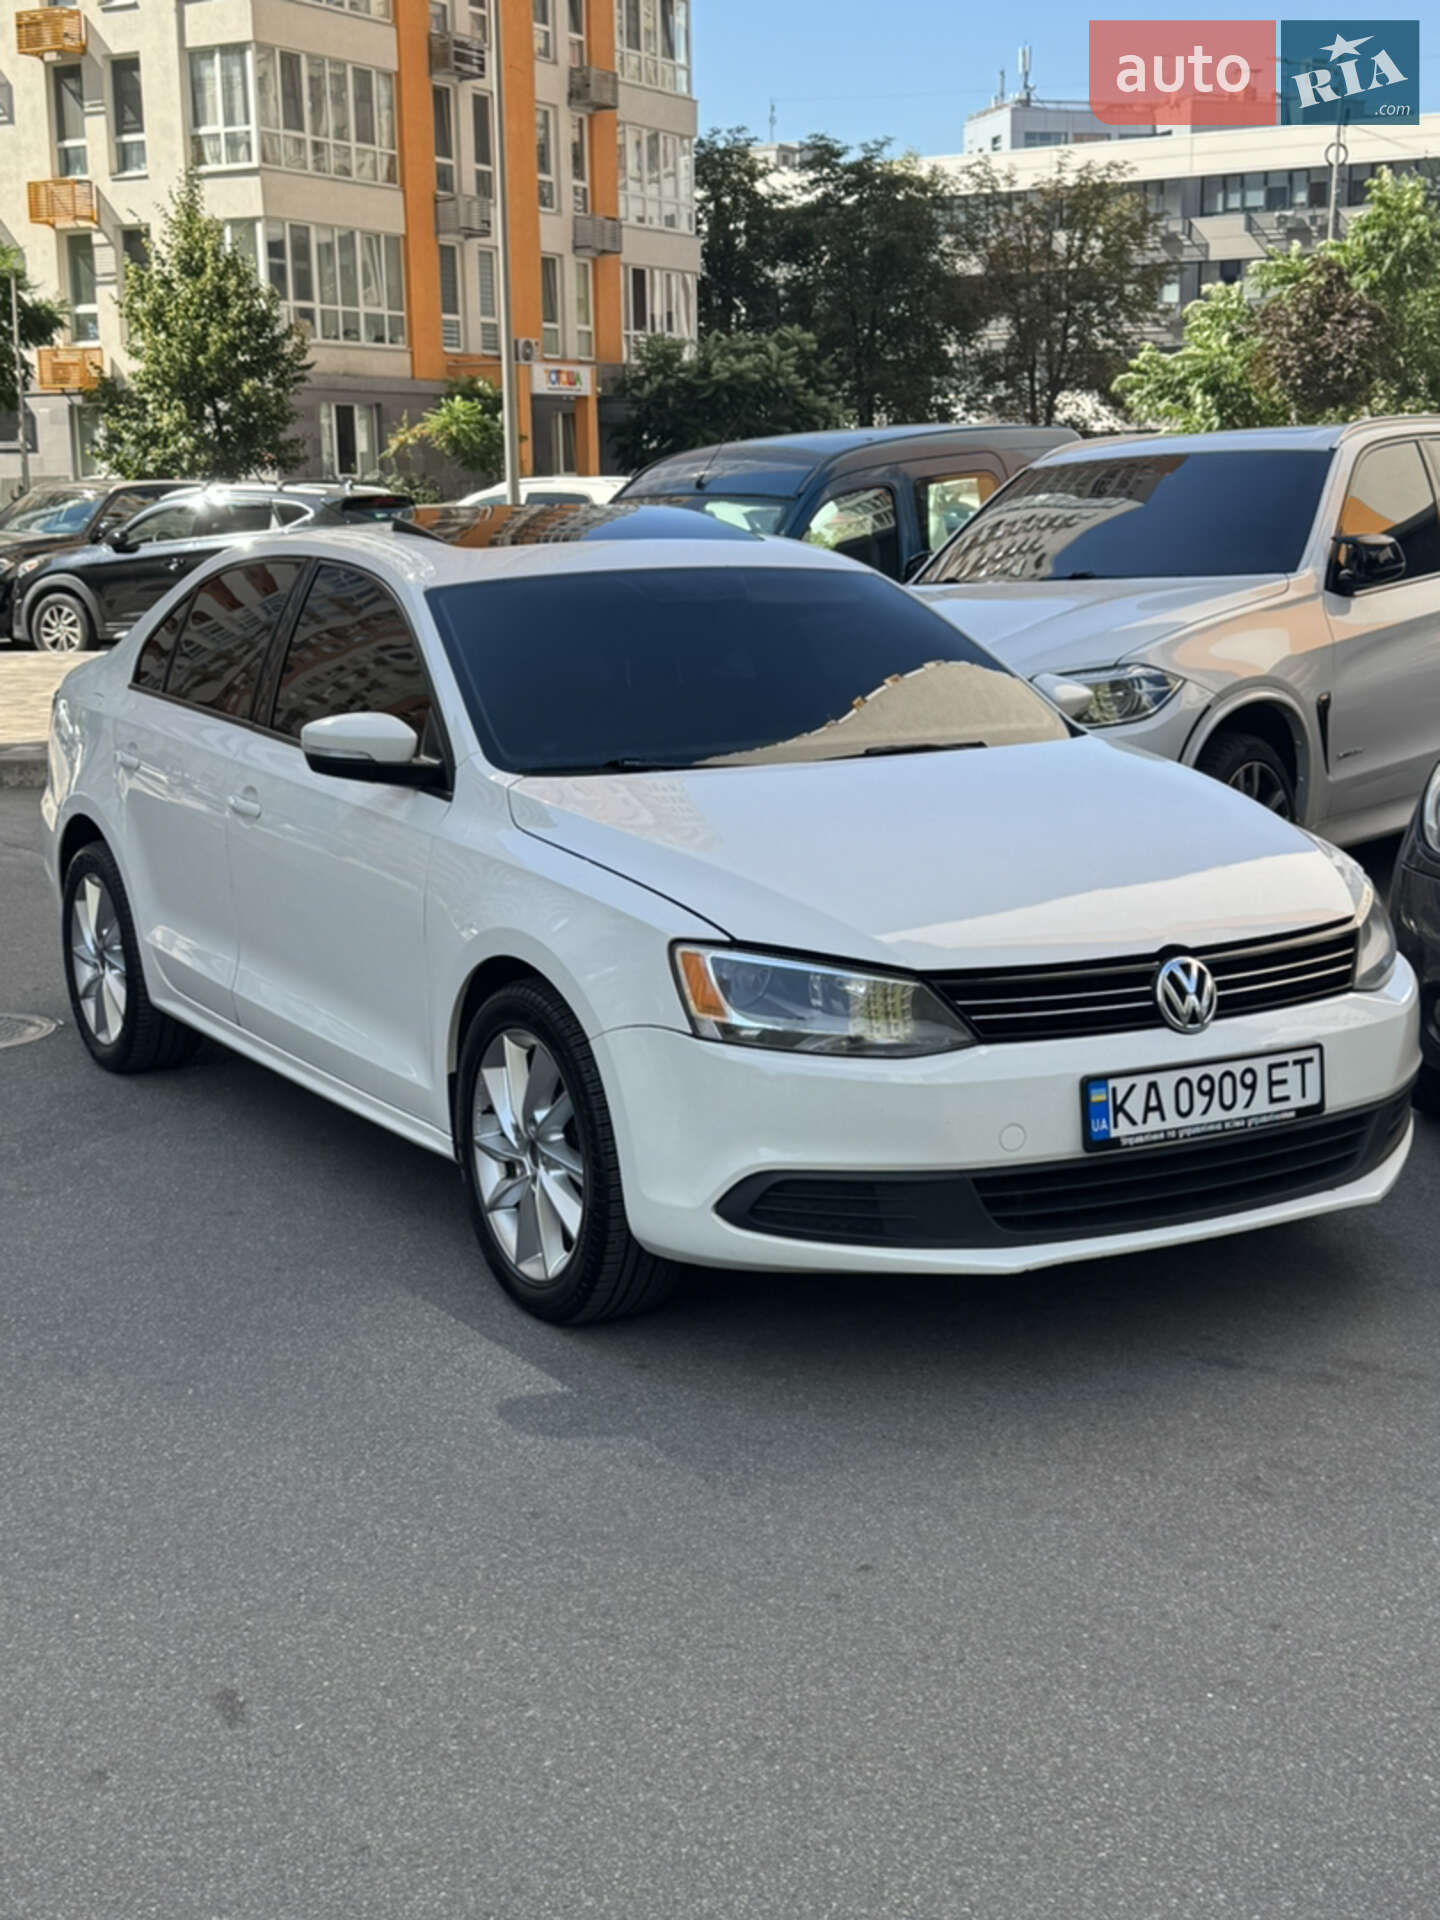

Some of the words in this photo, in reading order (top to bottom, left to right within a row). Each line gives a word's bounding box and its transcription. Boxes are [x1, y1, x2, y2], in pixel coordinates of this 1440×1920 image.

[1111, 1080, 1167, 1129] KA
[1174, 1067, 1258, 1118] 0909
[1267, 1056, 1315, 1105] ET
[1091, 1118, 1109, 1133] UA
